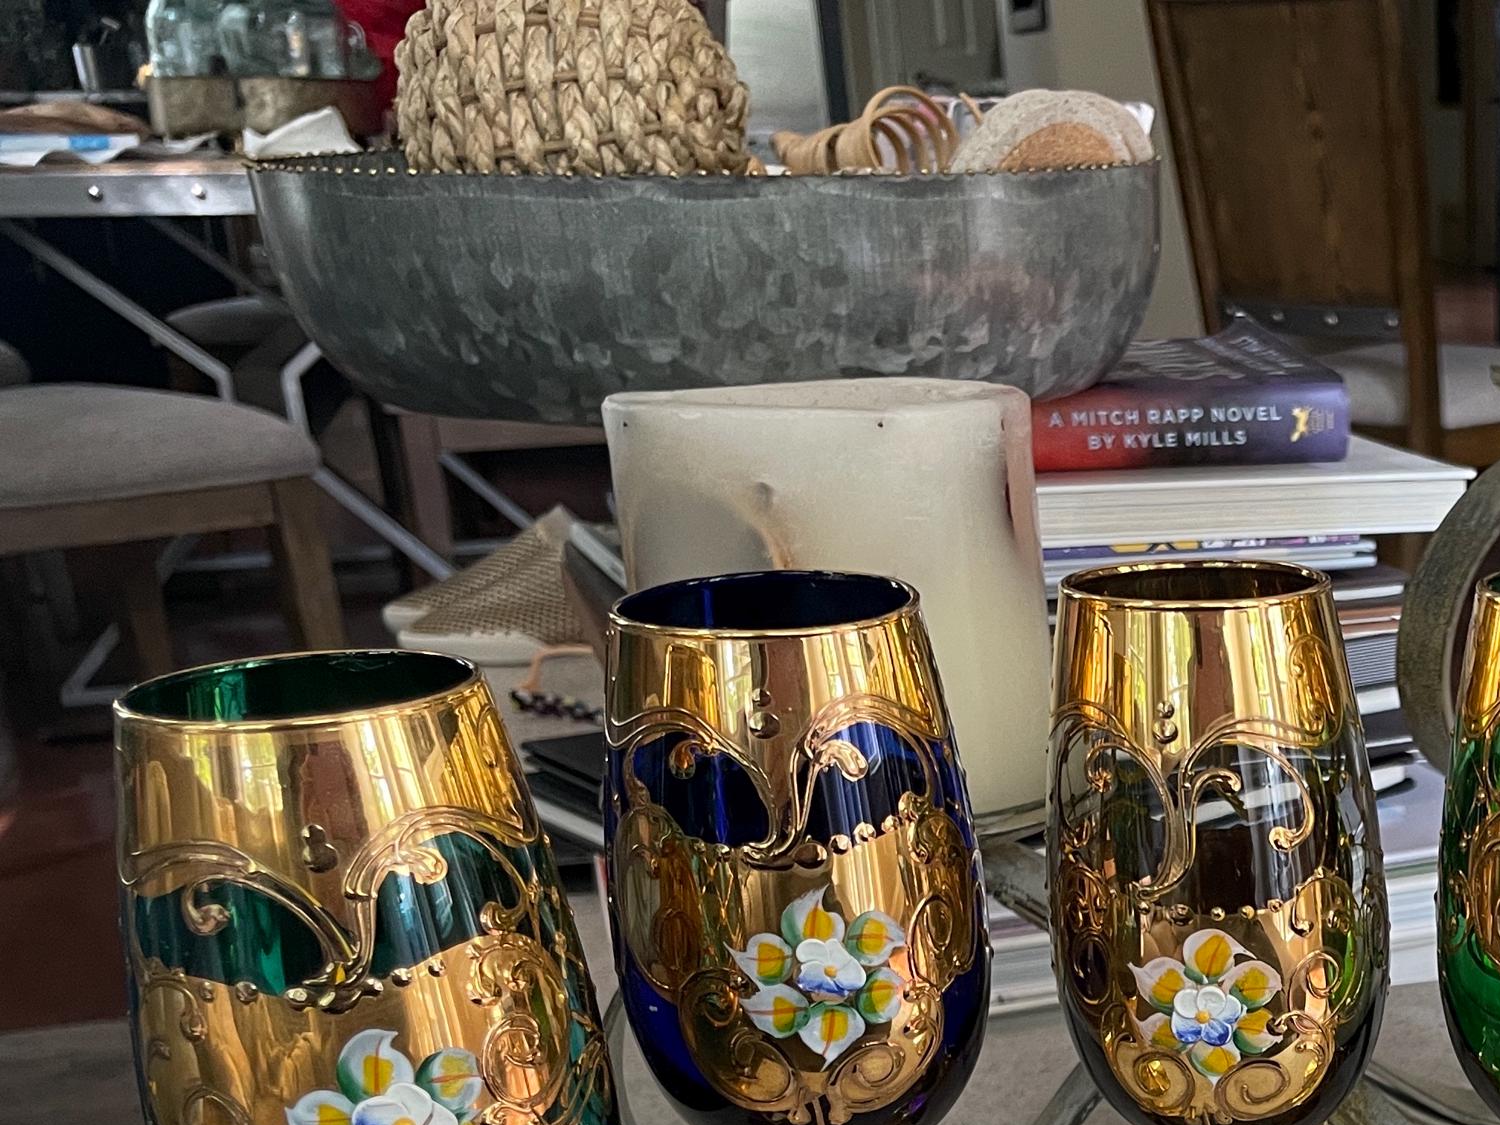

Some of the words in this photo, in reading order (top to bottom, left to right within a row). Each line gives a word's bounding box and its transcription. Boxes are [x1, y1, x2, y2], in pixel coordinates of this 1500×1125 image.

[1048, 411, 1064, 428] A
[1071, 408, 1140, 427] MITCH
[1146, 407, 1204, 424] RAPP
[1210, 404, 1282, 423] NOVEL
[1087, 432, 1116, 450] BY
[1123, 431, 1178, 449] KYLE
[1184, 429, 1247, 447] MILLS
